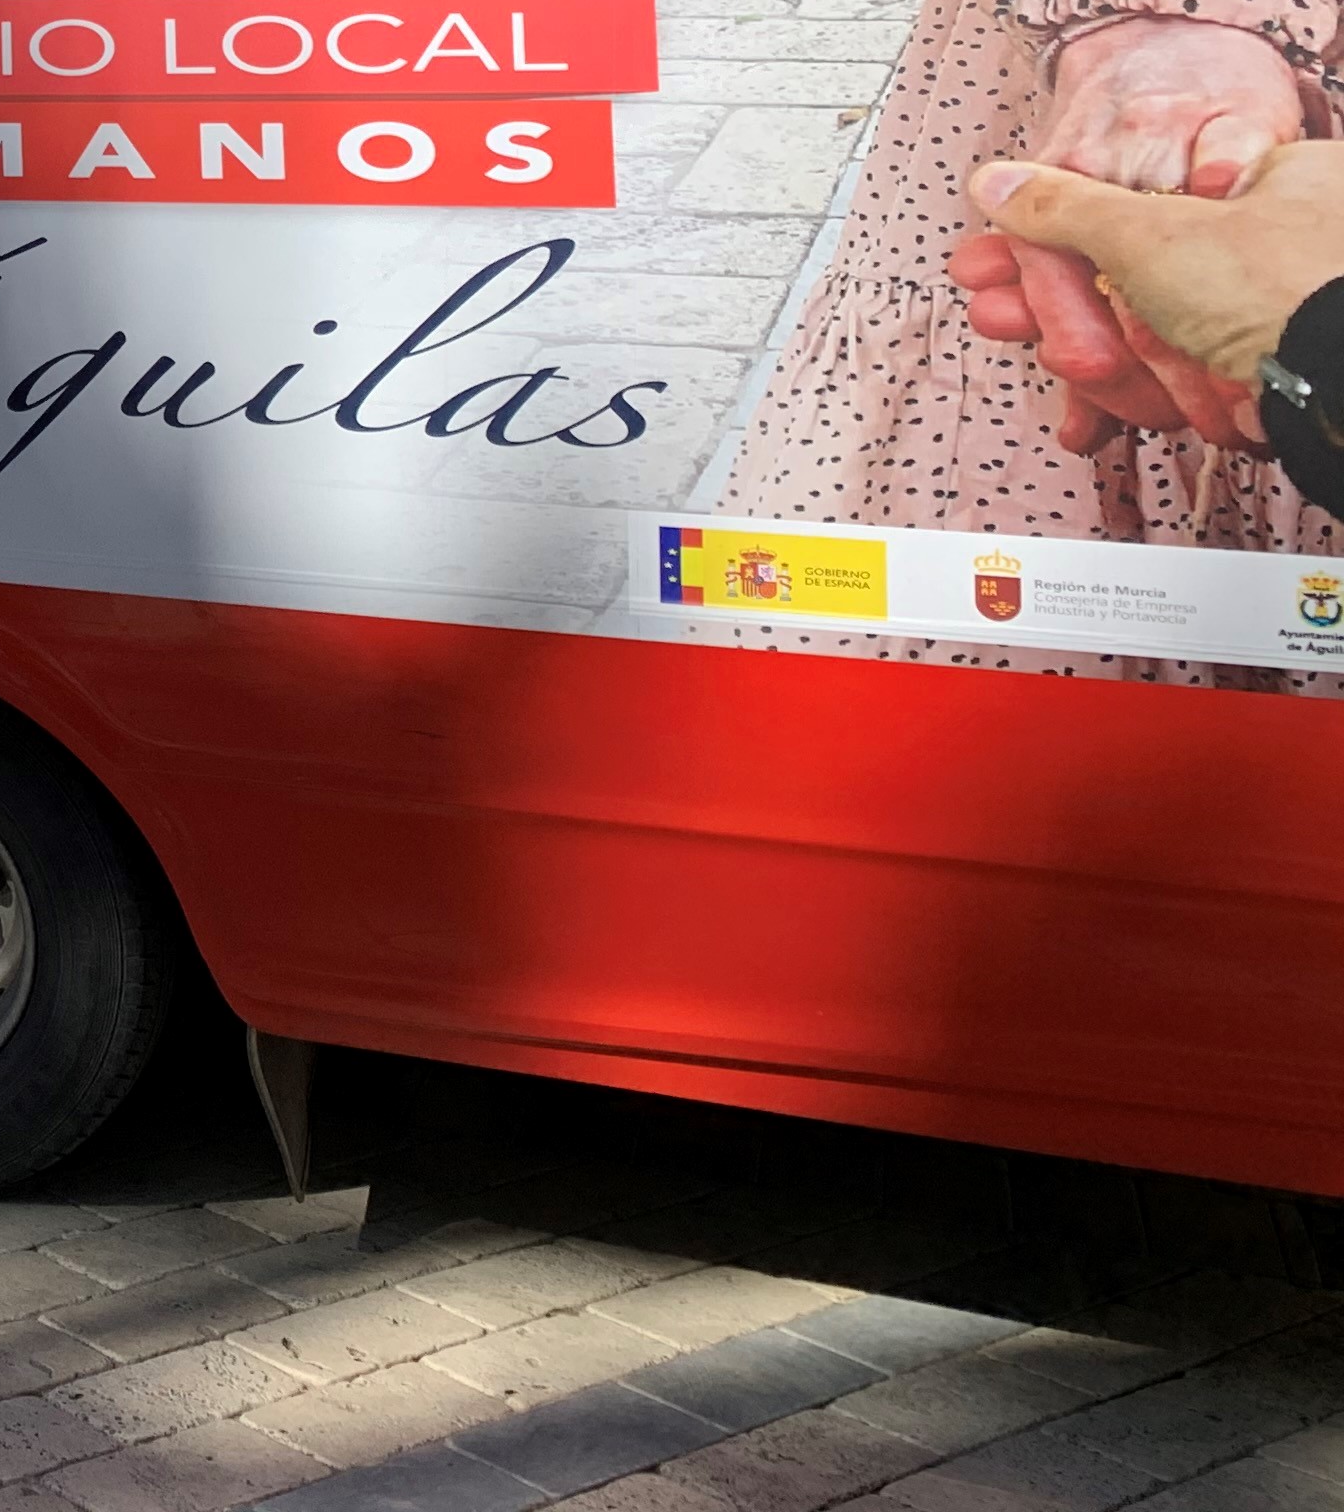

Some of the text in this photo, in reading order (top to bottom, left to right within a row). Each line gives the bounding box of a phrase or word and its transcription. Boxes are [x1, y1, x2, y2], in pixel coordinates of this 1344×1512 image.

[164, 12, 569, 76] LOCAL
[804, 567, 871, 580] GOBIERNO
[804, 578, 871, 590] DE ESPAÑA
[1033, 579, 1168, 599] Región de Murcia
[1034, 604, 1096, 619] Industria
[1099, 610, 1109, 621] y
[1113, 597, 1132, 609] de
[1135, 600, 1199, 615] Empresa
[1287, 642, 1344, 655] de Águil
